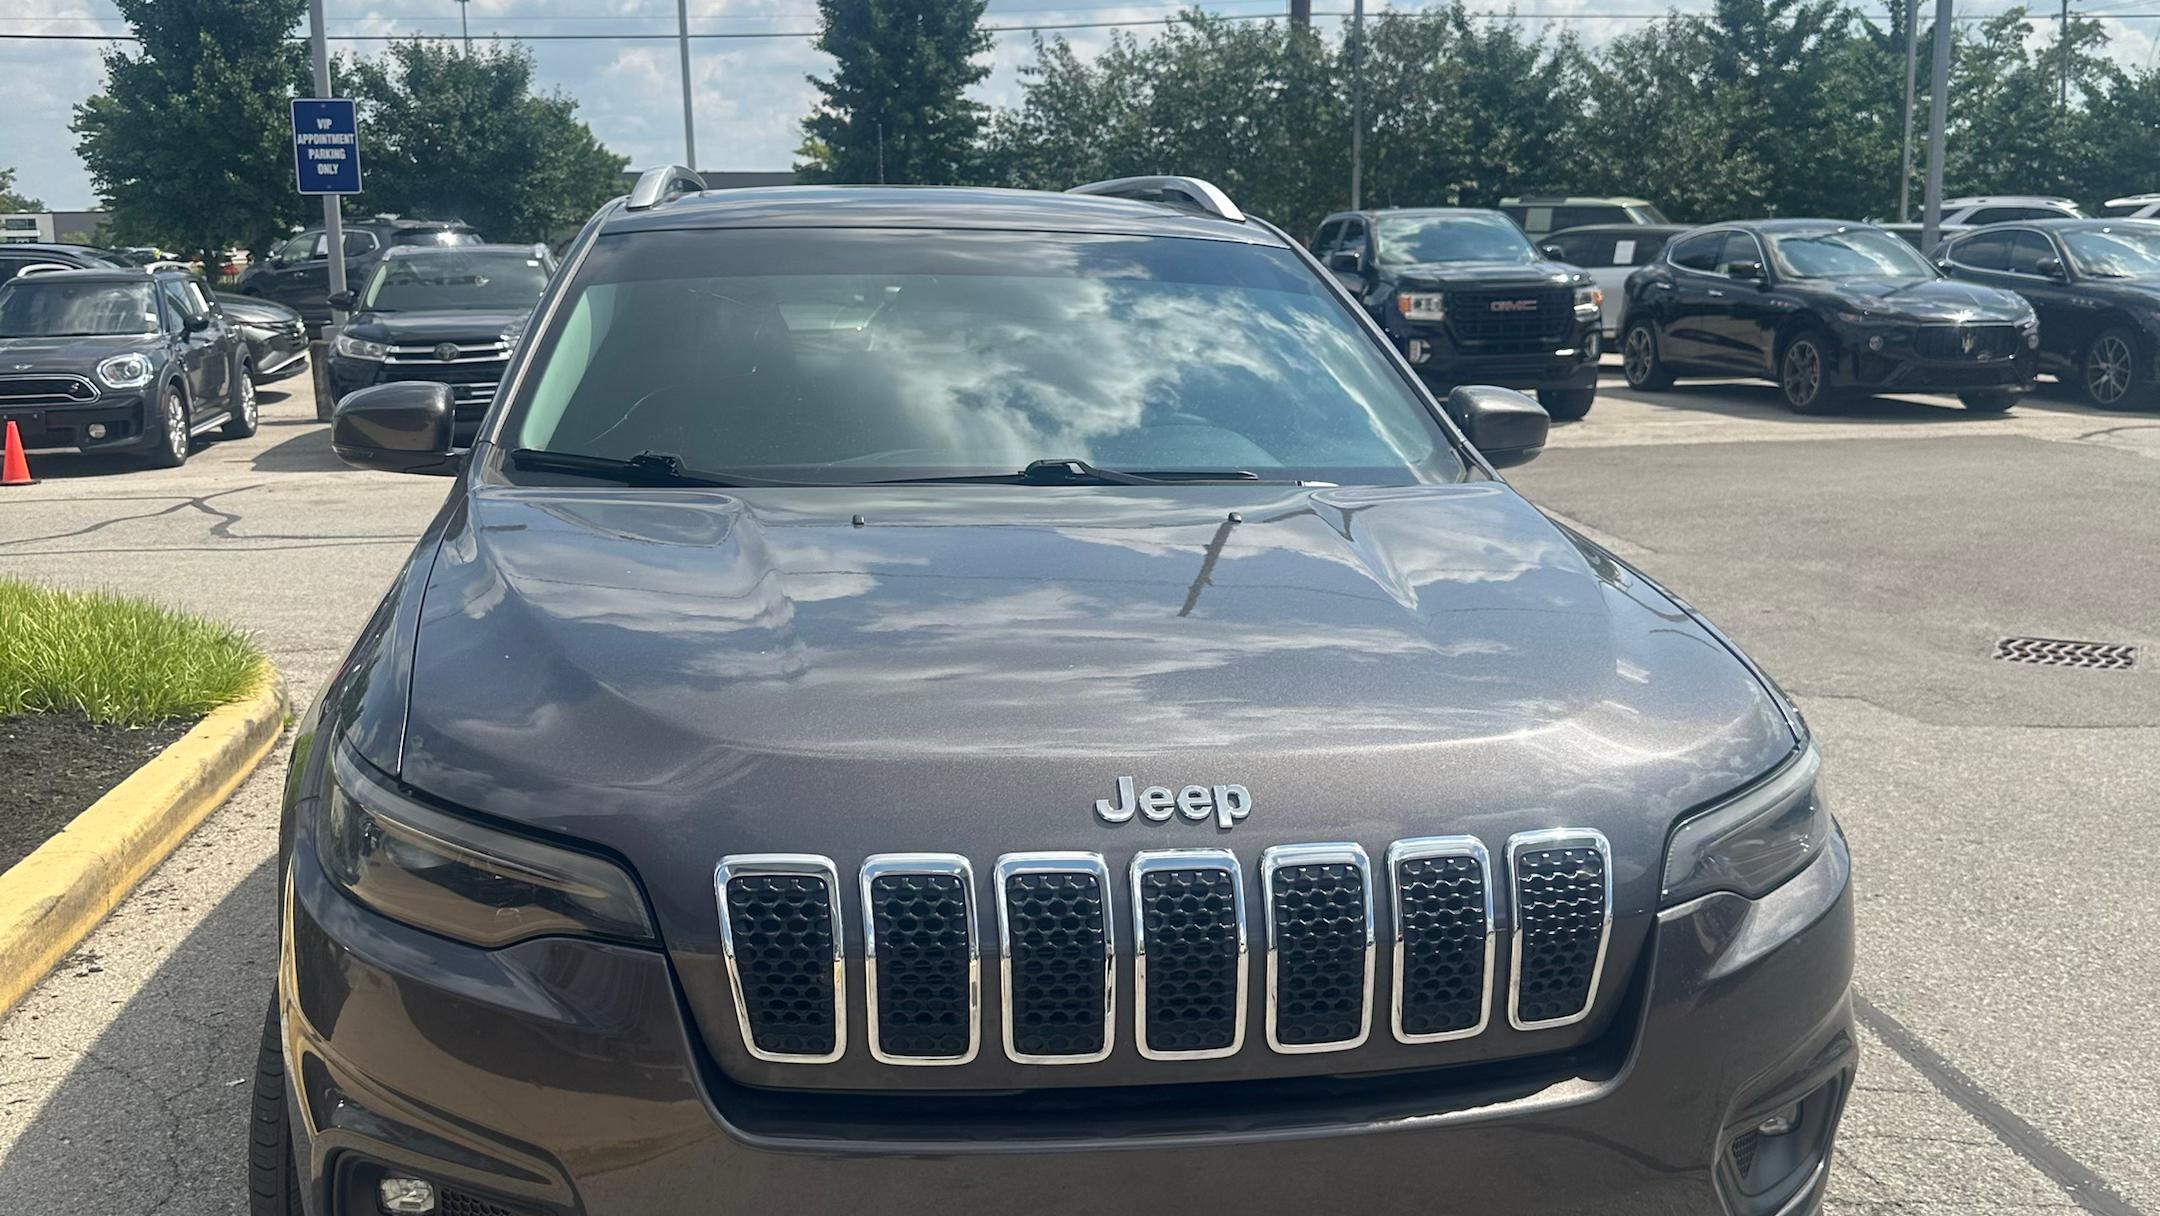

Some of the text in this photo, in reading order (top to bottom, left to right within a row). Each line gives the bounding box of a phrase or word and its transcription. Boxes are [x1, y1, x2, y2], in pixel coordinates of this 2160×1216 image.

[316, 118, 333, 130] VIP
[297, 133, 355, 145] APPOINTMENT
[308, 148, 347, 160] PARKING
[317, 163, 339, 175] ONLY
[1490, 300, 1537, 312] GMC
[1095, 776, 1252, 829] Jeep
